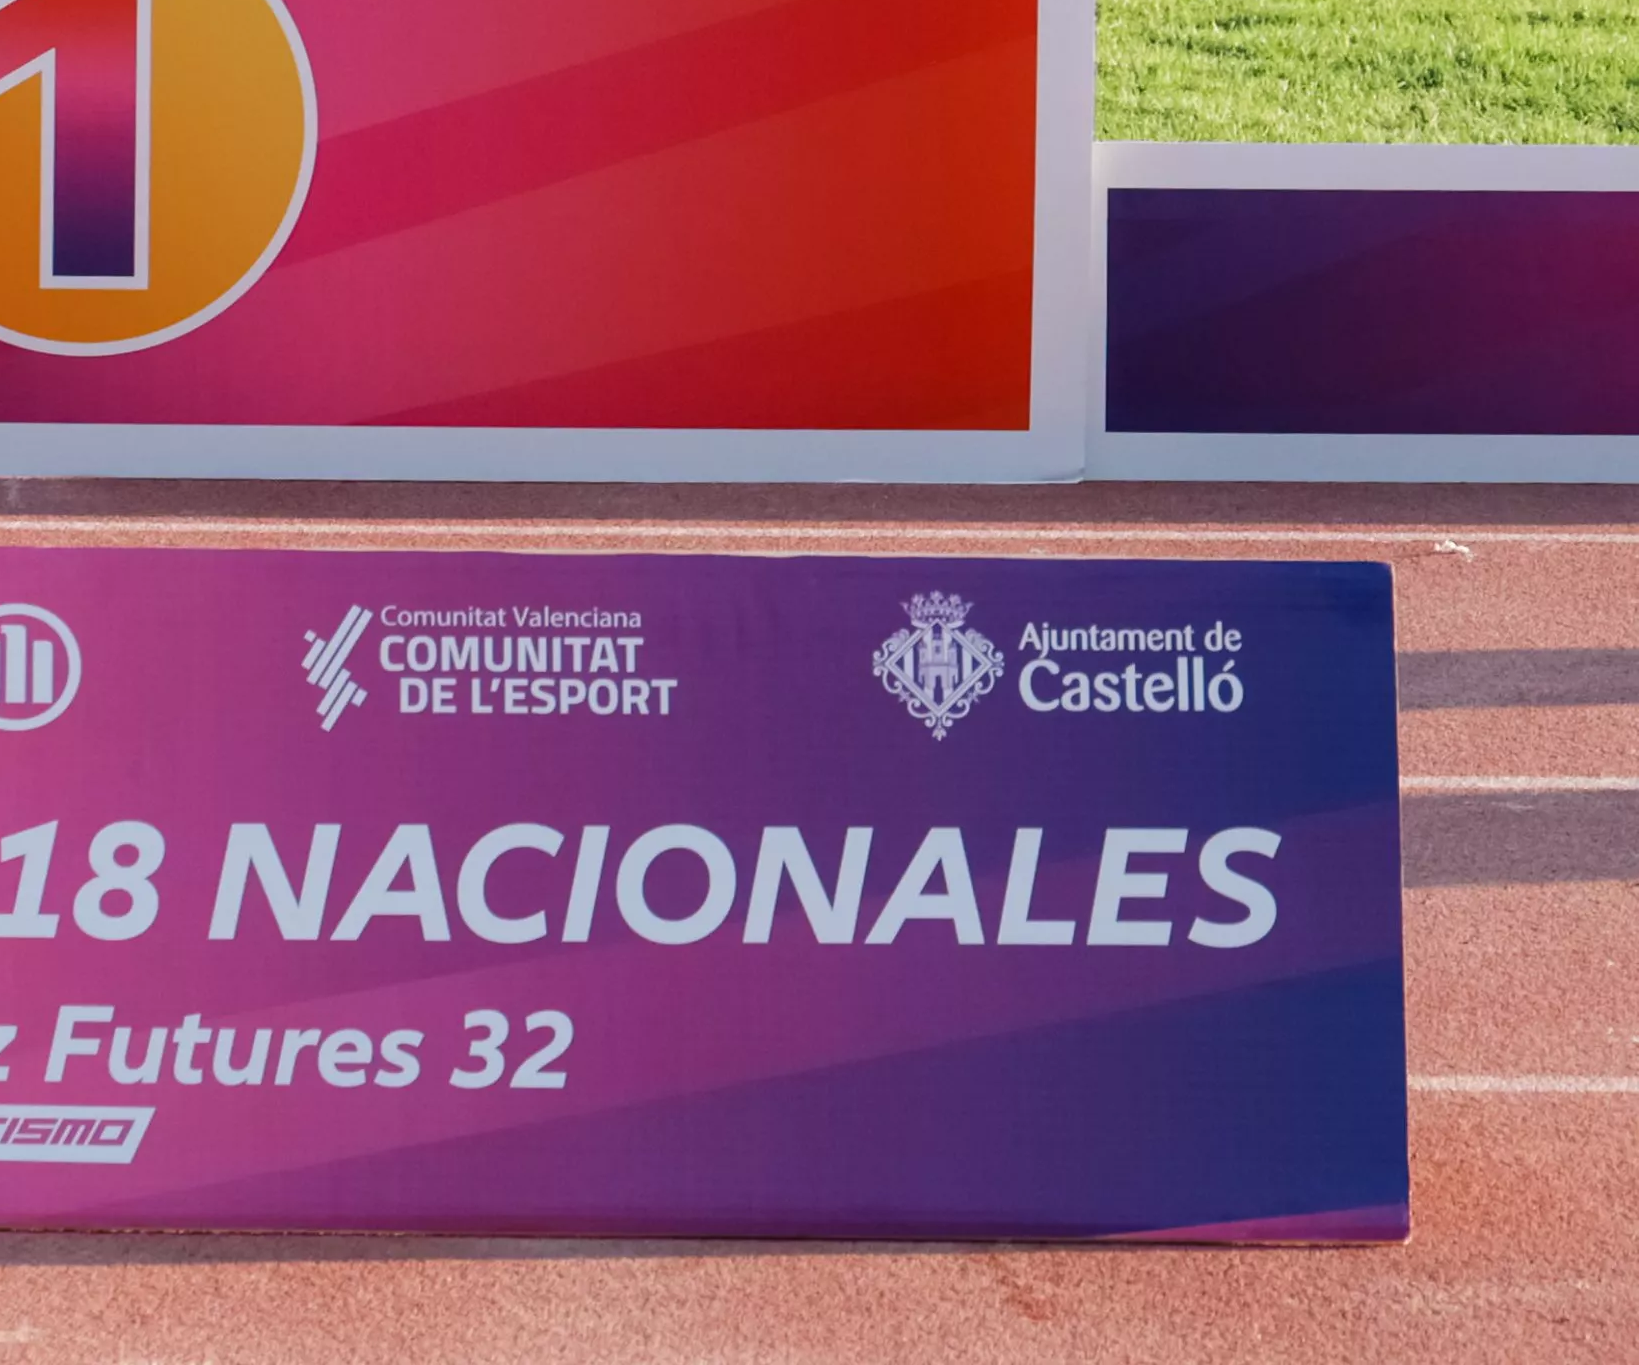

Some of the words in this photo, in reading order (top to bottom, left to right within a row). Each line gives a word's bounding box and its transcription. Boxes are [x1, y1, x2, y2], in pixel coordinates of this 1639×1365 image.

[380, 605, 507, 629] Comunitat
[513, 606, 643, 630] Valenciana
[379, 635, 644, 674] COMUNITAT
[1018, 621, 1195, 659] Ajuntament
[1203, 620, 1243, 652] de
[399, 677, 458, 714] DE
[471, 678, 678, 716] L'ESPORT
[1018, 656, 1245, 713] Castelló
[208, 822, 1283, 949] NACIONALES
[44, 1004, 425, 1088] Futures
[449, 1009, 575, 1090] 32
